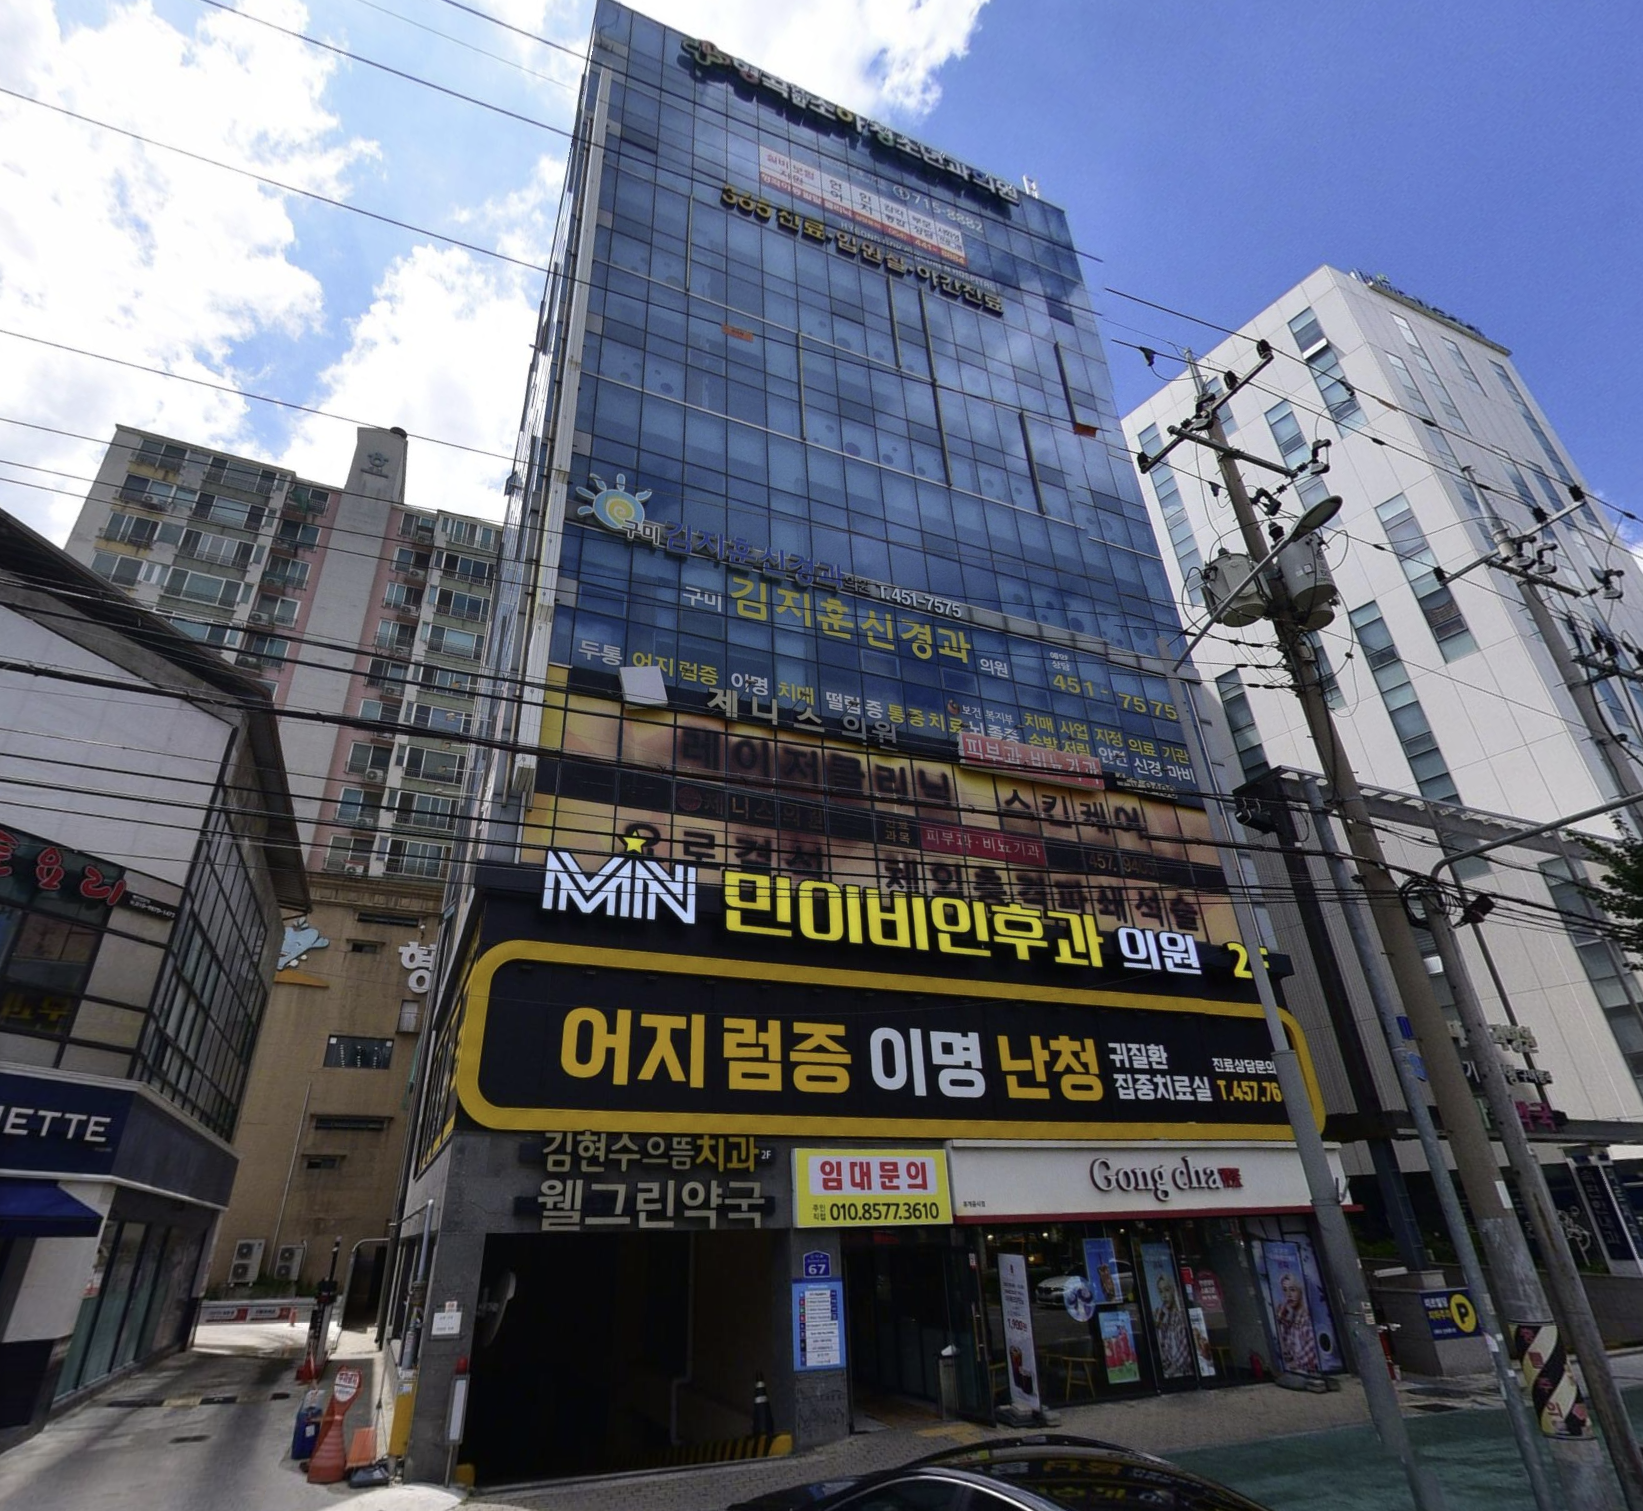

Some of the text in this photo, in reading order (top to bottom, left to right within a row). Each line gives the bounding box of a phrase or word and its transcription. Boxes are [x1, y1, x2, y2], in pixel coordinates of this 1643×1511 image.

[722, 184, 772, 219] 365
[622, 519, 661, 546] 구미
[663, 520, 843, 590] 김지훈신경과
[877, 584, 963, 619] T.451-7575
[682, 576, 1010, 679] 구미 김지훈신경과 의원
[578, 639, 623, 667] 두통
[730, 671, 769, 696] 이명
[777, 680, 815, 706] 치매
[961, 704, 982, 720] 보건
[1023, 712, 1055, 734] 치매
[1060, 720, 1090, 741] 사업
[1094, 728, 1124, 748] 지정
[1127, 737, 1158, 758] 의료
[1161, 745, 1190, 765] 기관
[1133, 757, 1163, 778] 신경
[1168, 764, 1196, 784] 마비
[884, 829, 912, 845] 과목
[542, 851, 697, 925] MIN
[724, 870, 1105, 969] 민이비인후과
[1116, 926, 1202, 976] 의원
[560, 1006, 1104, 1103] 어지럼증 이명 난청
[1107, 1042, 1169, 1070] 귀질환
[1211, 1057, 1278, 1075] 진료상담문의
[1113, 1073, 1214, 1103] 집중치료실
[760, 1149, 772, 1160] 2F
[819, 1160, 929, 1192] 임대문의
[1089, 1156, 1171, 1202] Gong
[1171, 1155, 1223, 1190] cha
[537, 1179, 766, 1232] 웰그린약국
[829, 1201, 940, 1221] 010.8577.3610
[808, 1263, 827, 1275] 67
